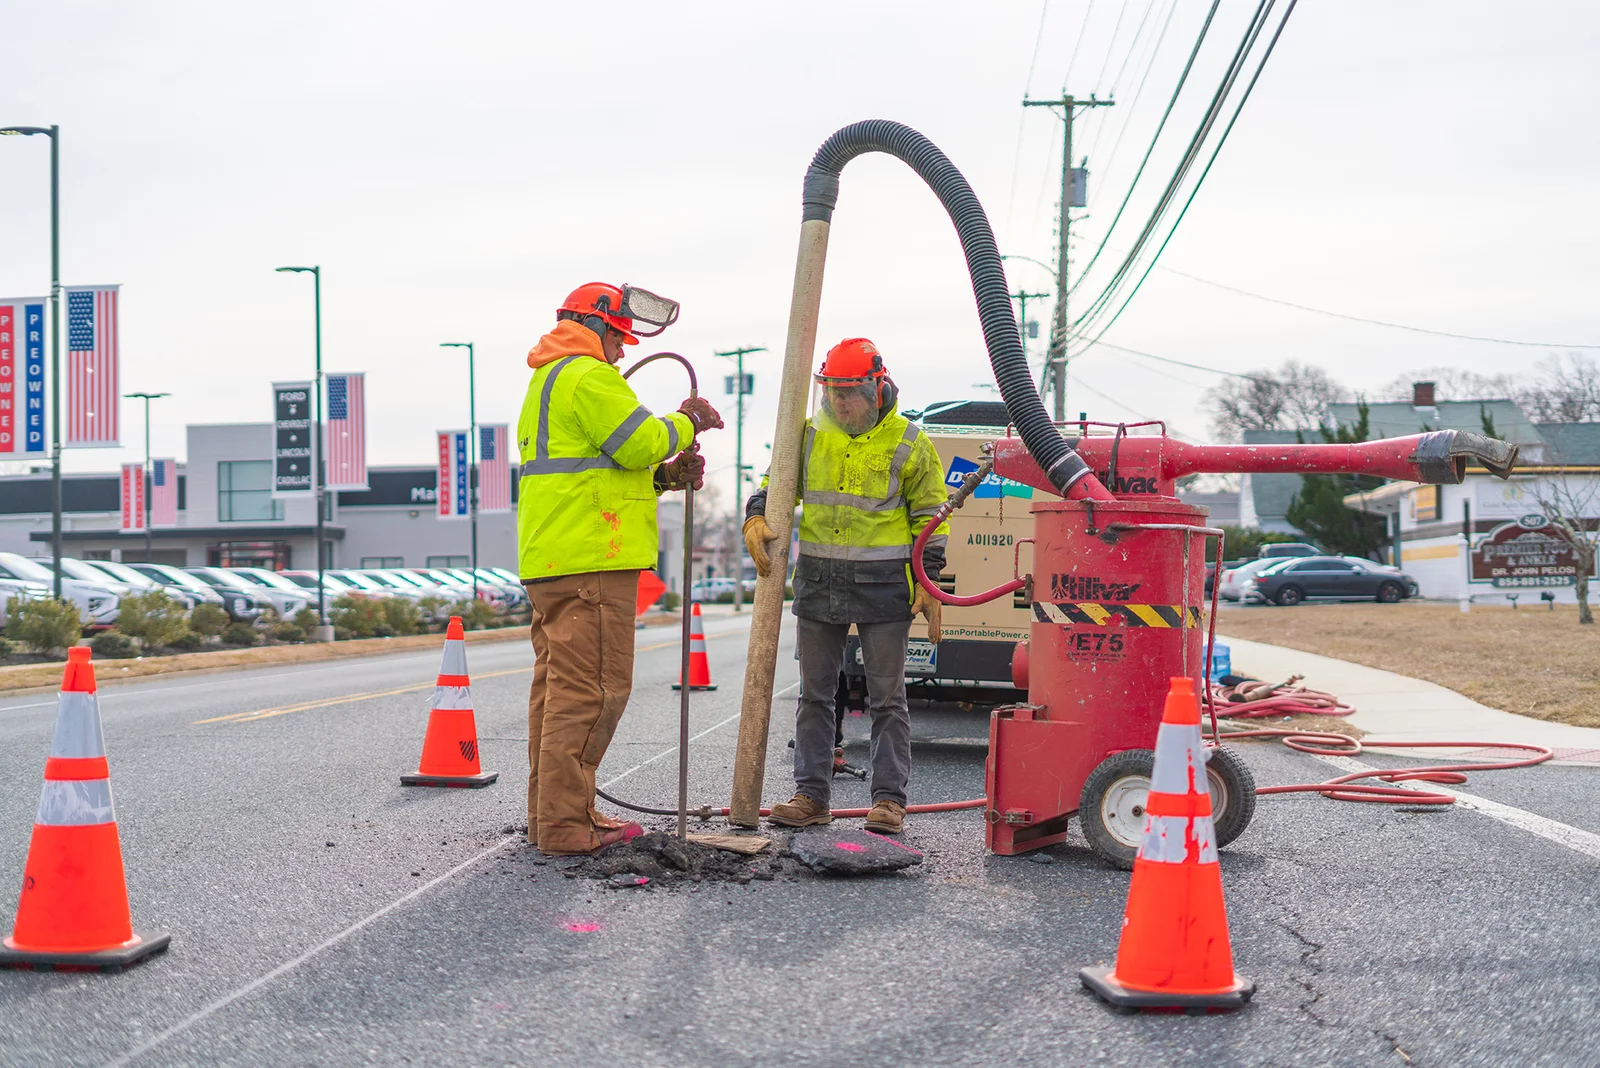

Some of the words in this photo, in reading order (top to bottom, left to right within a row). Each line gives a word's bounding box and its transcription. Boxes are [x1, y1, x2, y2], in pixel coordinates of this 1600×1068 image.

[0, 315, 12, 444] PREOWNED
[29, 314, 42, 443] PREOWNED
[279, 391, 306, 401] FORD
[277, 447, 311, 458] LINCOLN
[277, 475, 311, 486] CADILLAC
[947, 471, 1029, 487] DOSA
[967, 534, 1013, 546] A011920
[1482, 544, 1541, 562] PREMIER
[1518, 554, 1557, 565] ANKLE
[1512, 567, 1538, 575] JOHN
[1541, 566, 1576, 575] PELOSI
[941, 628, 1030, 640] osanPortablePower.c
[906, 648, 931, 657] SAN
